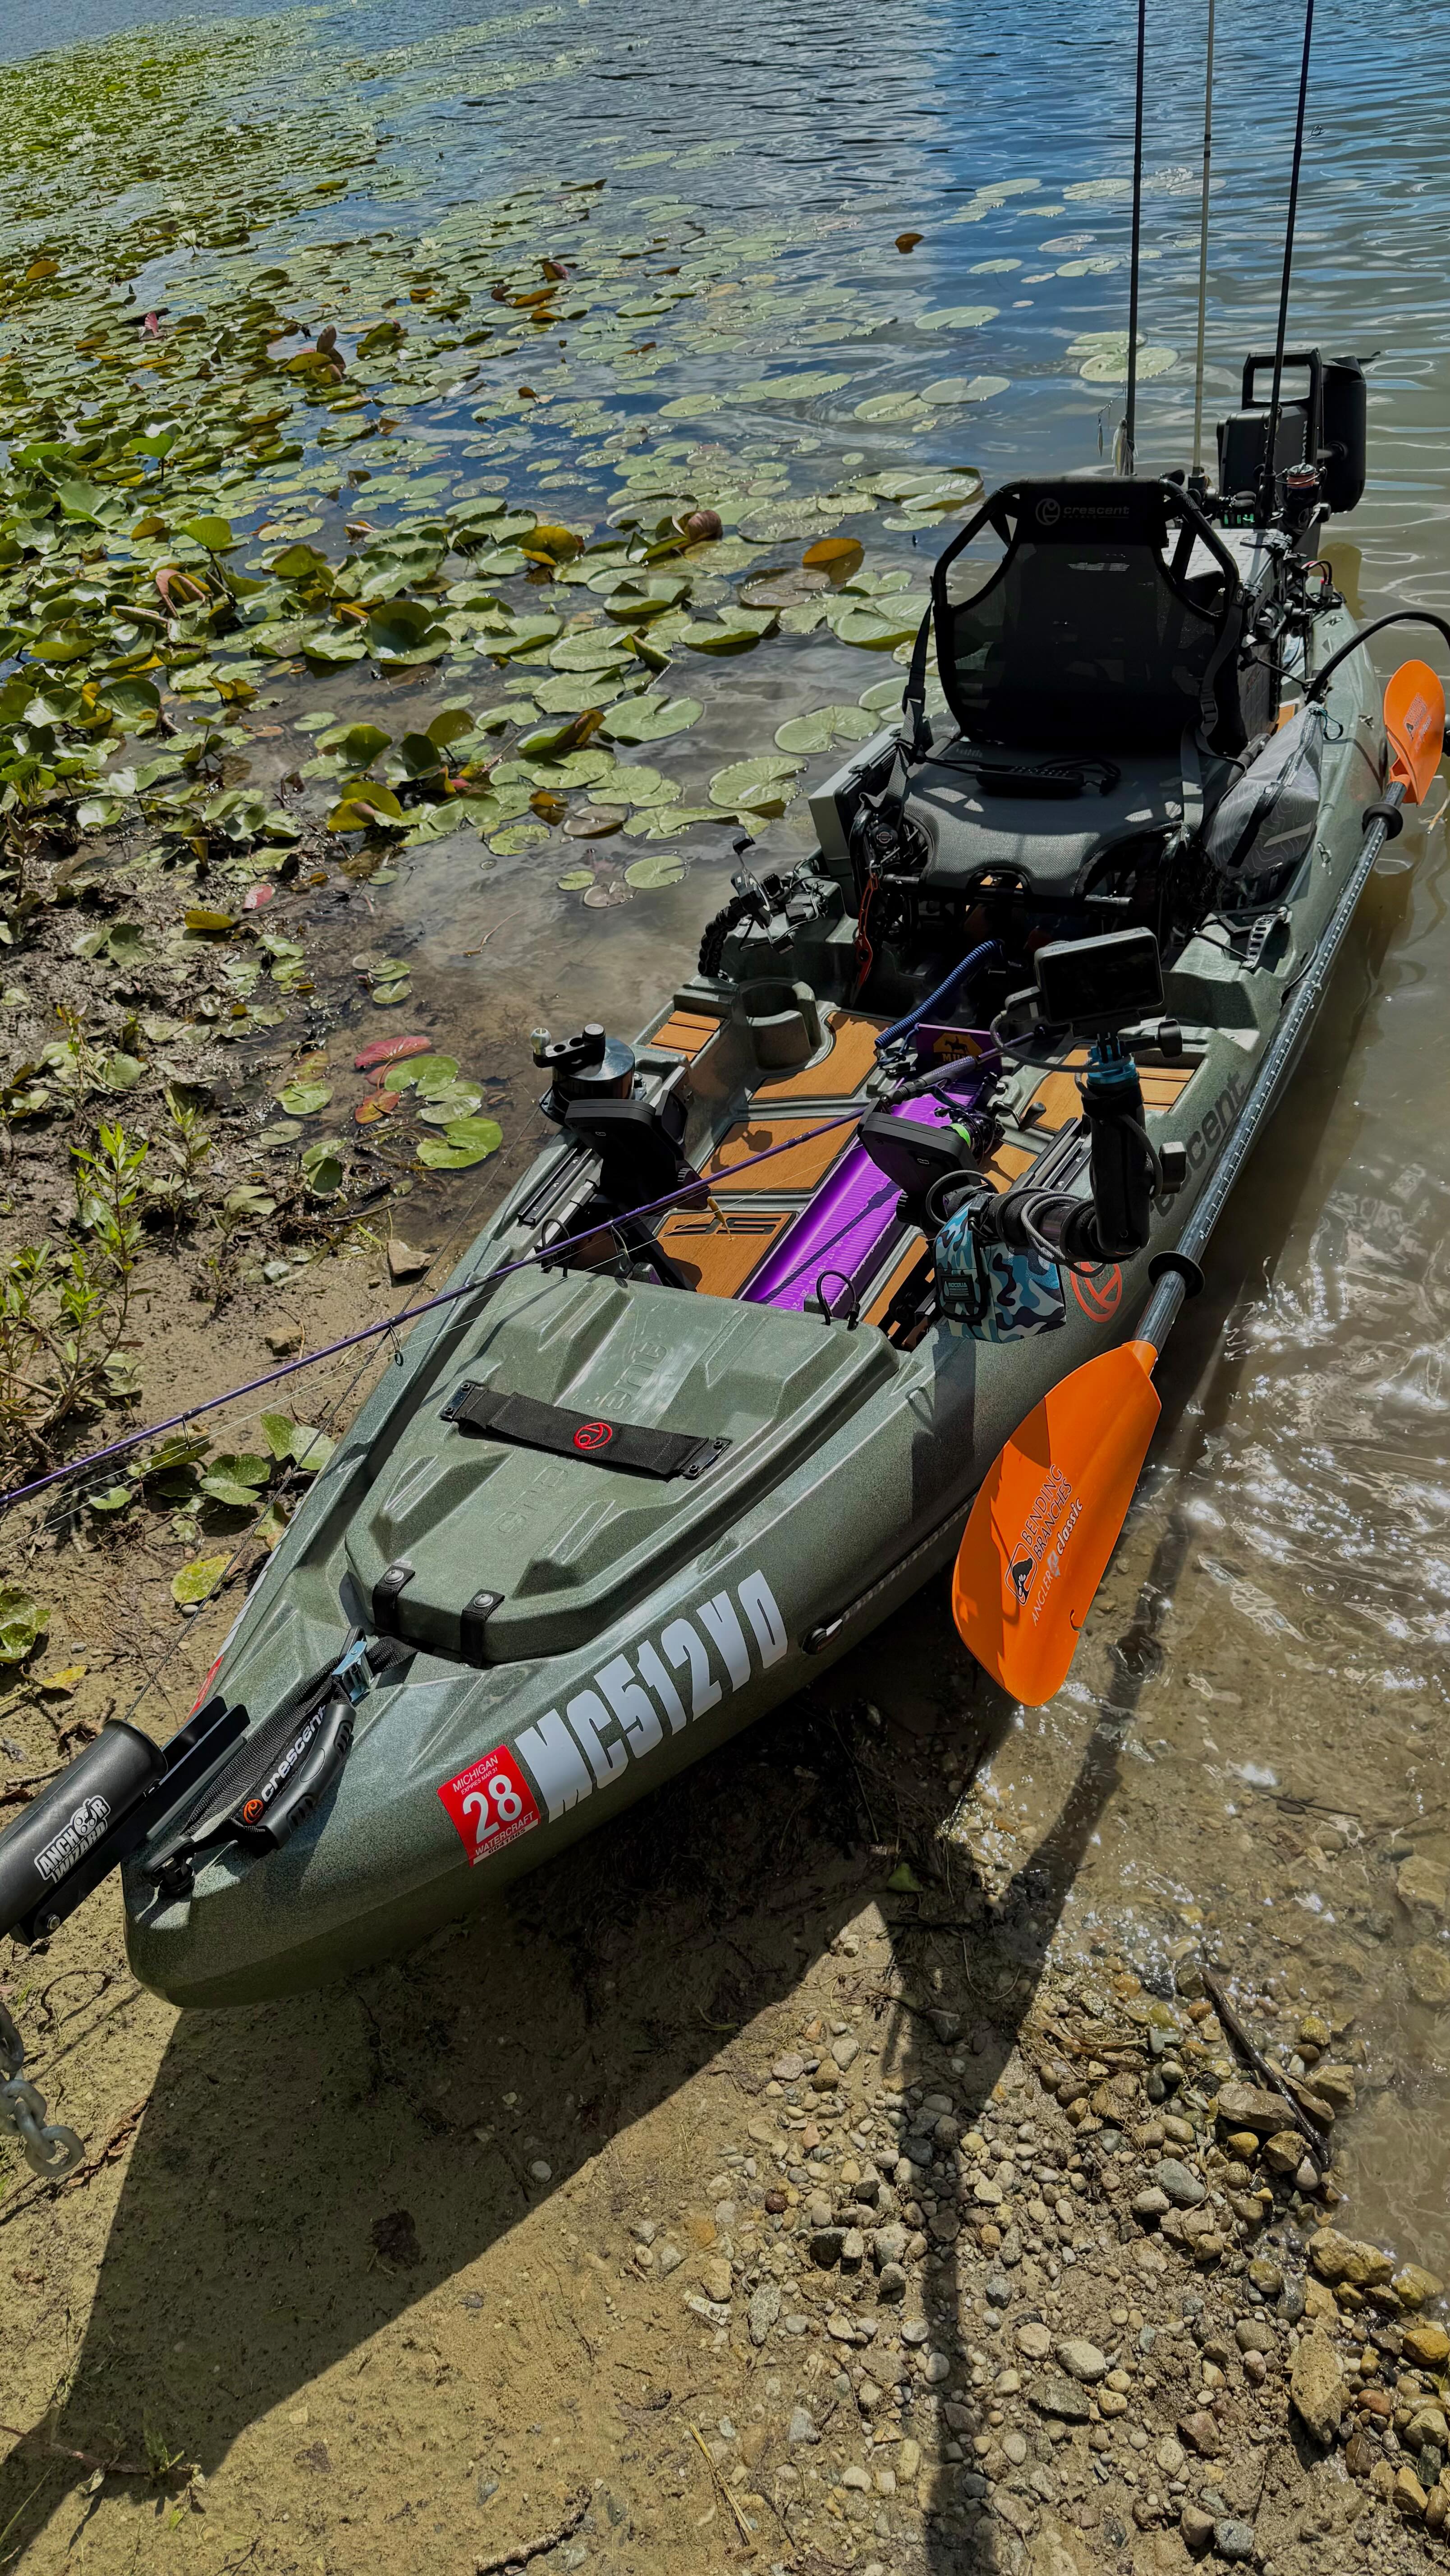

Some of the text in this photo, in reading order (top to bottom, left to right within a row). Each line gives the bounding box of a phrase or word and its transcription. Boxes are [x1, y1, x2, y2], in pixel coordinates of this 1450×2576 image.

[1064, 506, 1129, 515] crescent
[1022, 1464, 1062, 1546] BENDING
[1033, 1478, 1072, 1561] BRANCHES
[1031, 1497, 1083, 1627] ANGLER classic
[453, 1755, 498, 1792] MICHIGAN
[461, 1779, 482, 1795] EXPIRES
[481, 1771, 492, 1780] MAR
[463, 1774, 523, 1844] 28
[475, 1811, 533, 1856] WATERCRAFT
[55, 1822, 106, 1880] WIZARD
